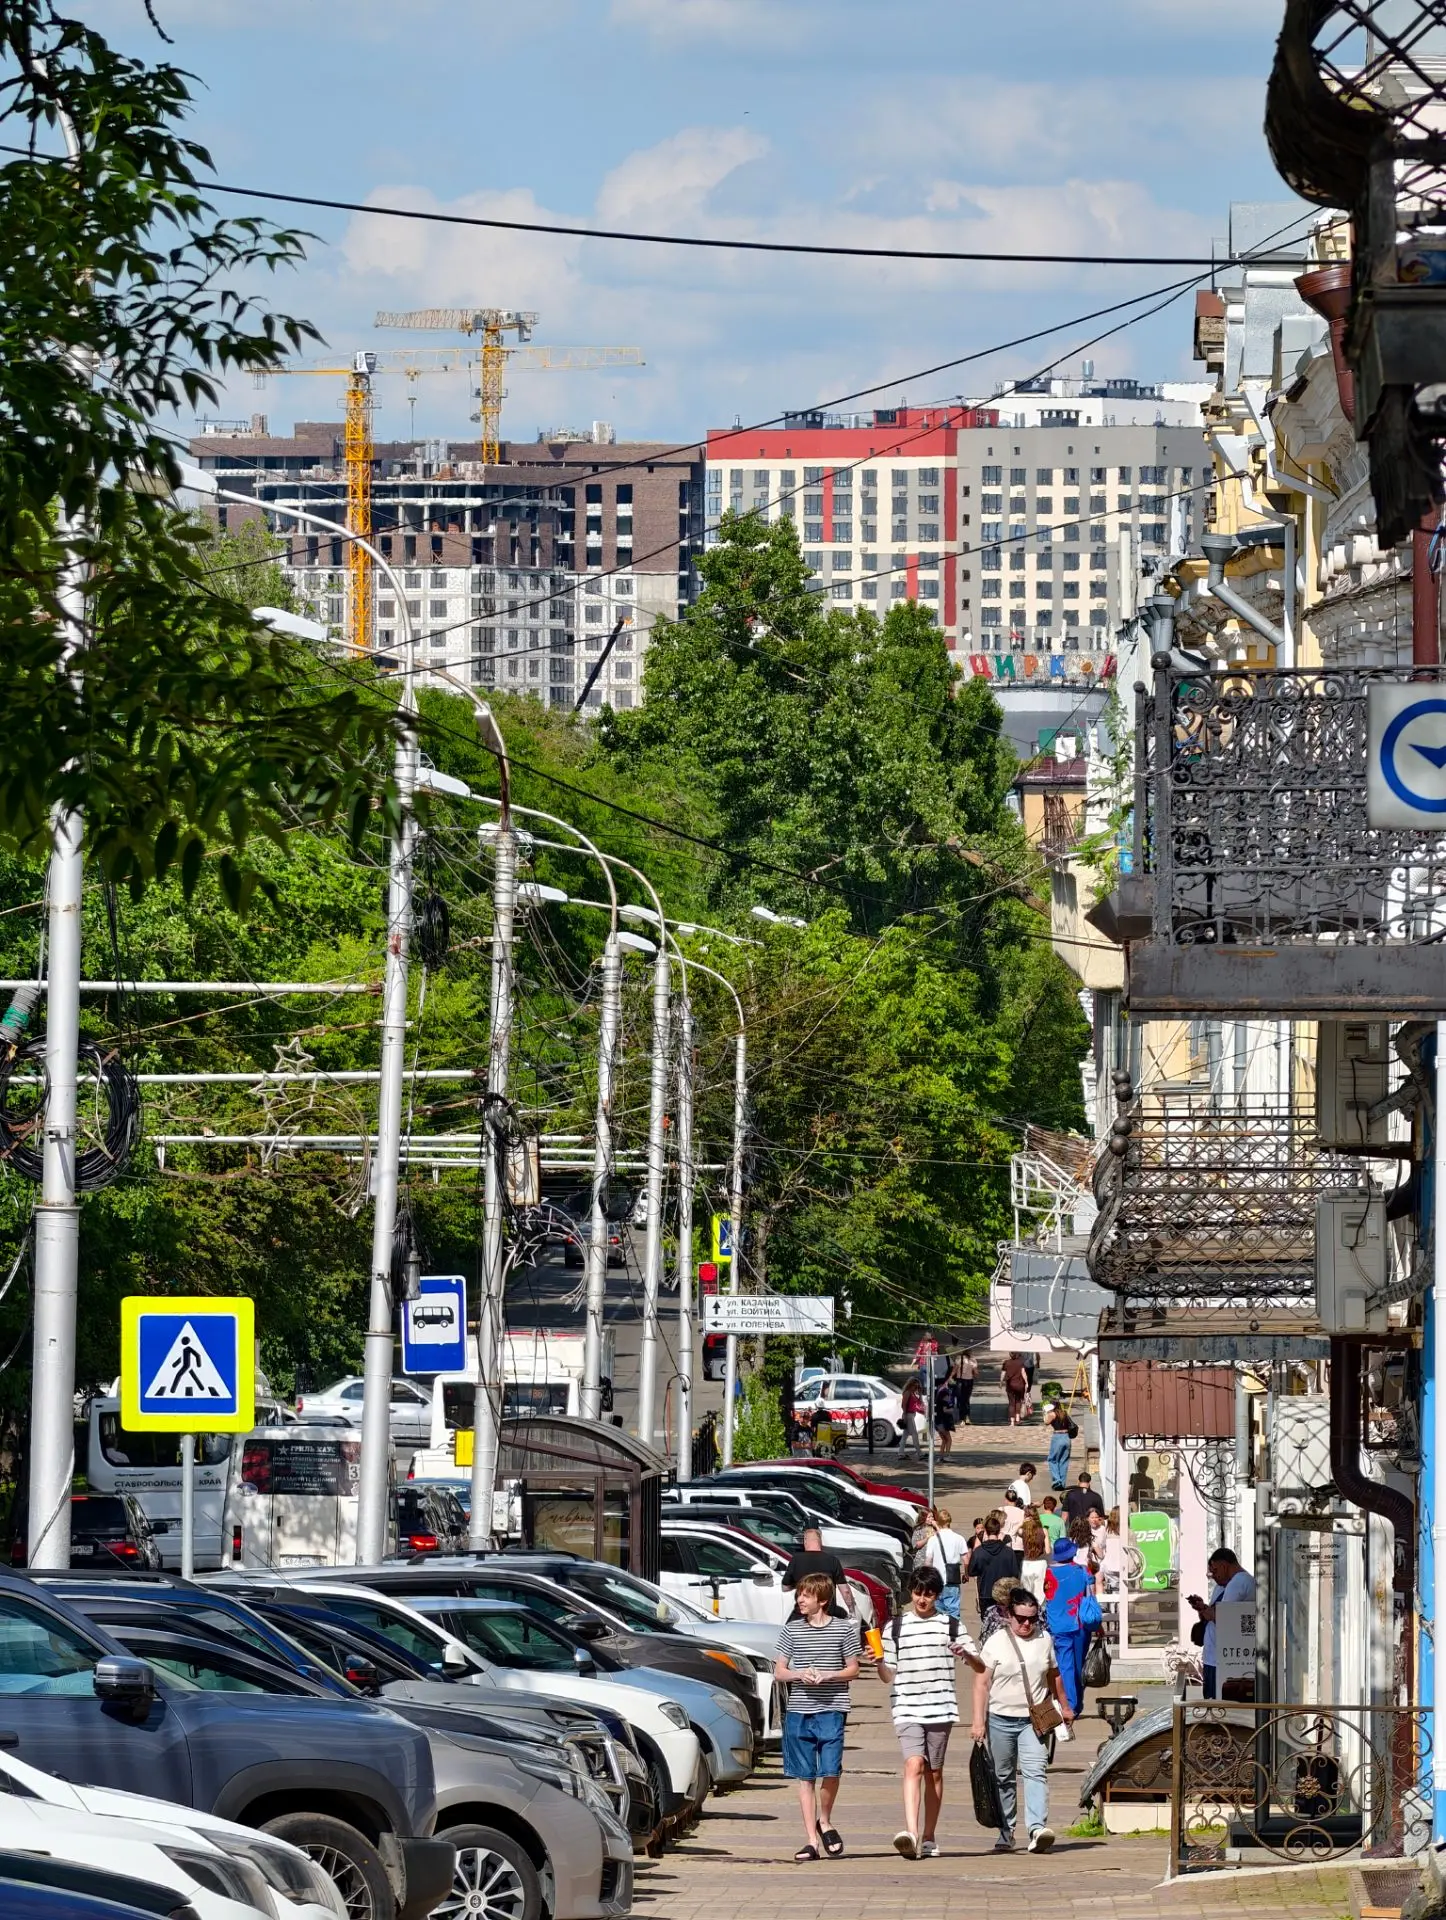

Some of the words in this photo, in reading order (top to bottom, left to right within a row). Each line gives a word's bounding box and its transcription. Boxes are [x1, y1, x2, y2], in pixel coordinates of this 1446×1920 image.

[969, 655, 1065, 680] ЦИРК
[726, 1300, 738, 1308] ул.
[741, 1299, 780, 1307] КАЗАЧЬЯ
[726, 1308, 738, 1316] ул.
[741, 1307, 781, 1315] ВОЙТИКА
[726, 1321, 738, 1329] ул.
[741, 1321, 786, 1329] ГОЛЕНЕВА
[114, 1480, 184, 1488] СТАВРОПОЛЬСК
[1134, 1528, 1167, 1543] DEK
